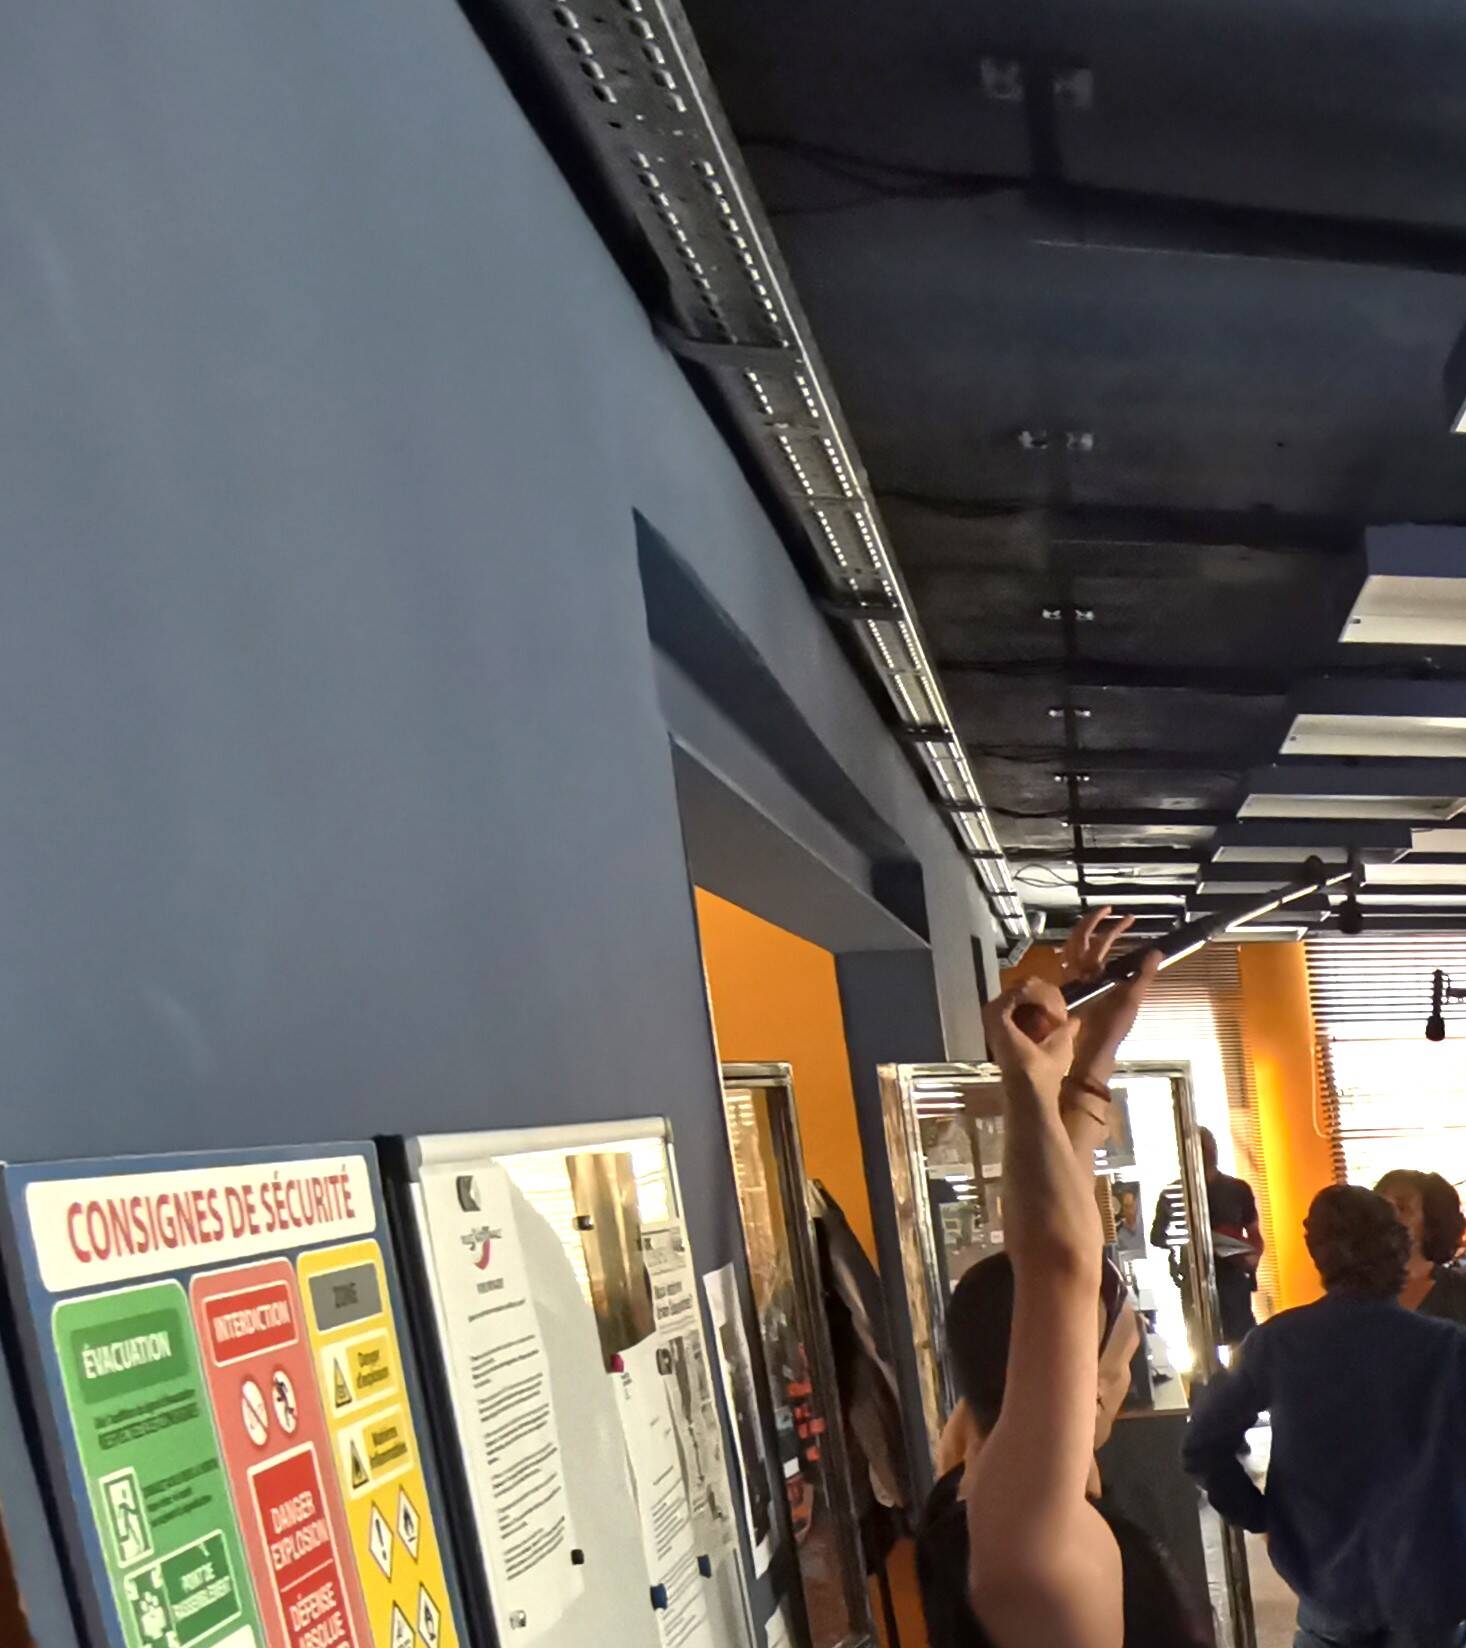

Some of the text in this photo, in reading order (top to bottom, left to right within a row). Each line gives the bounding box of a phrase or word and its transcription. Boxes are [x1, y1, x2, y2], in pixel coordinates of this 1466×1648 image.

[67, 1164, 355, 1263] CONSIGNES DE SÉCURITÉ
[213, 1301, 290, 1342] INTERDICTION
[82, 1331, 171, 1378] ÉVACUATION
[270, 1490, 315, 1534] DANGER
[270, 1518, 329, 1571] EXPLOSION
[289, 1582, 337, 1632] DÉFENSE
